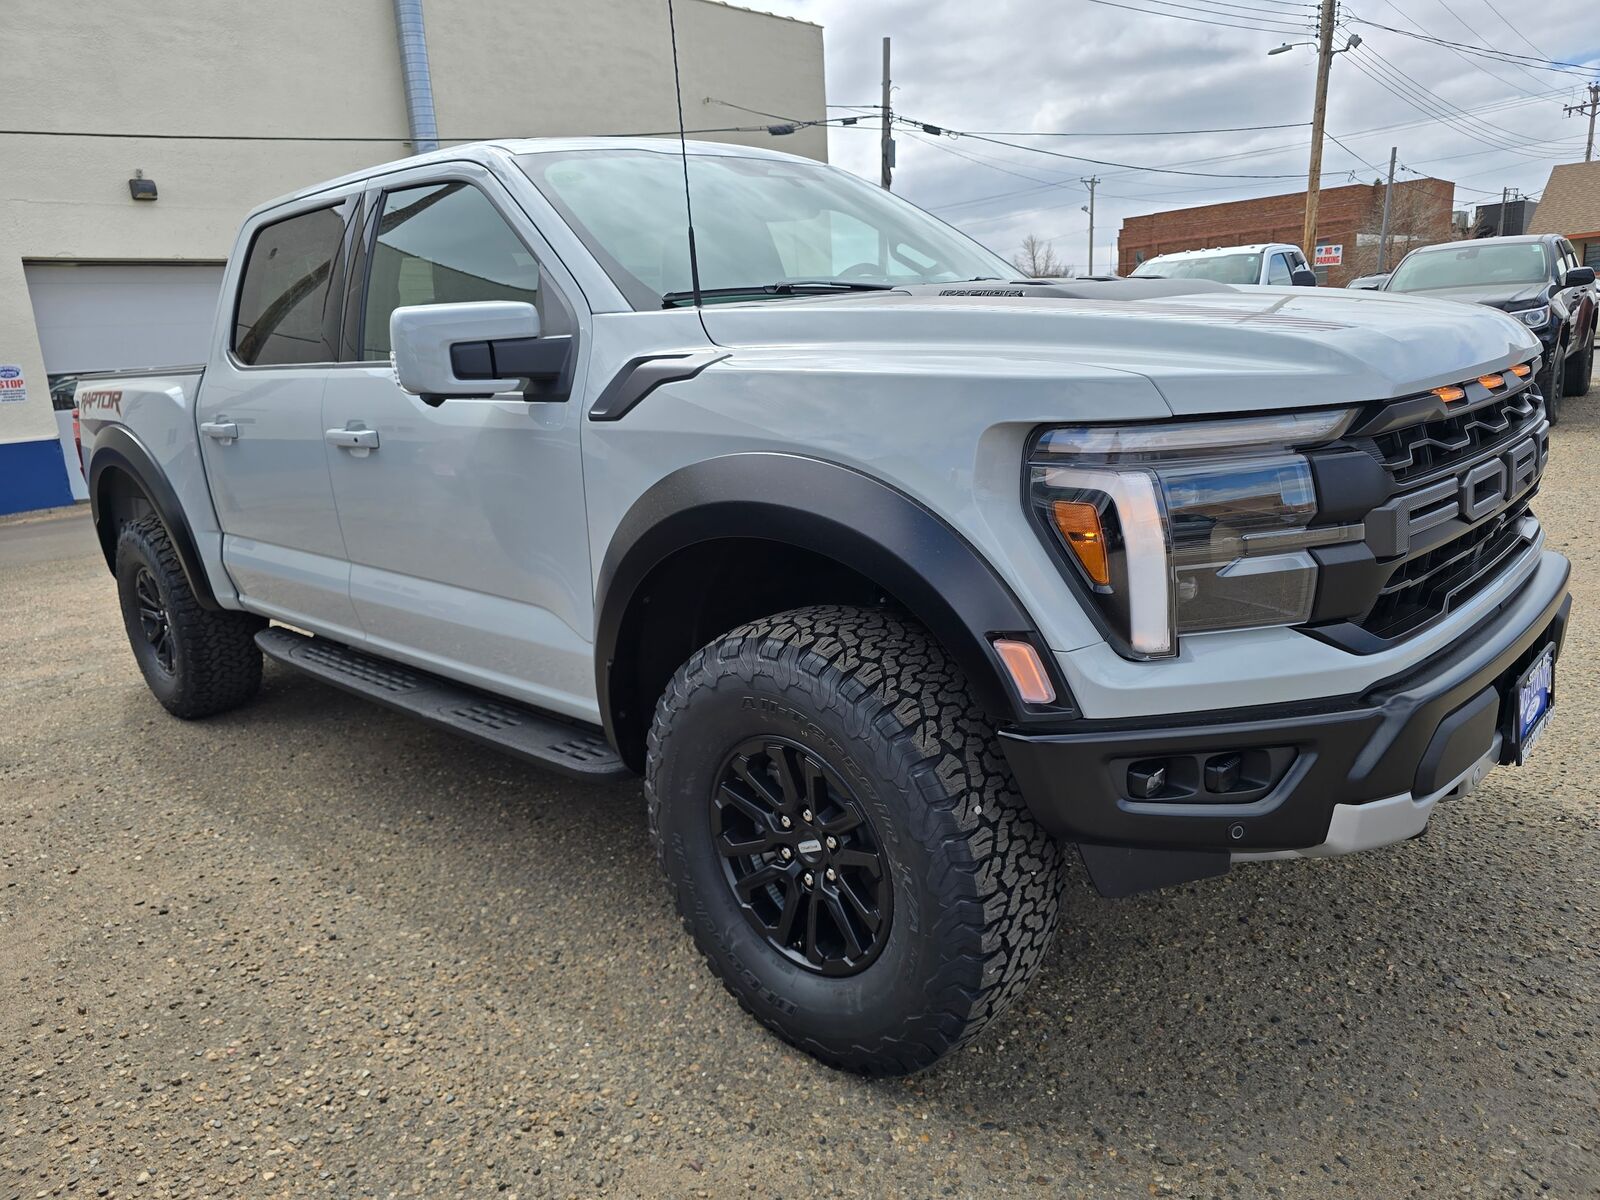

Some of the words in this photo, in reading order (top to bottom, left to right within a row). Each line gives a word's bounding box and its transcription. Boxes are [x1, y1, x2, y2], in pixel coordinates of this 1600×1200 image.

[1325, 247, 1333, 255] NO
[1316, 255, 1340, 265] PARKING
[938, 289, 1024, 298] RAPTOR
[0, 379, 24, 389] STOP
[81, 390, 122, 417] RAPTOR
